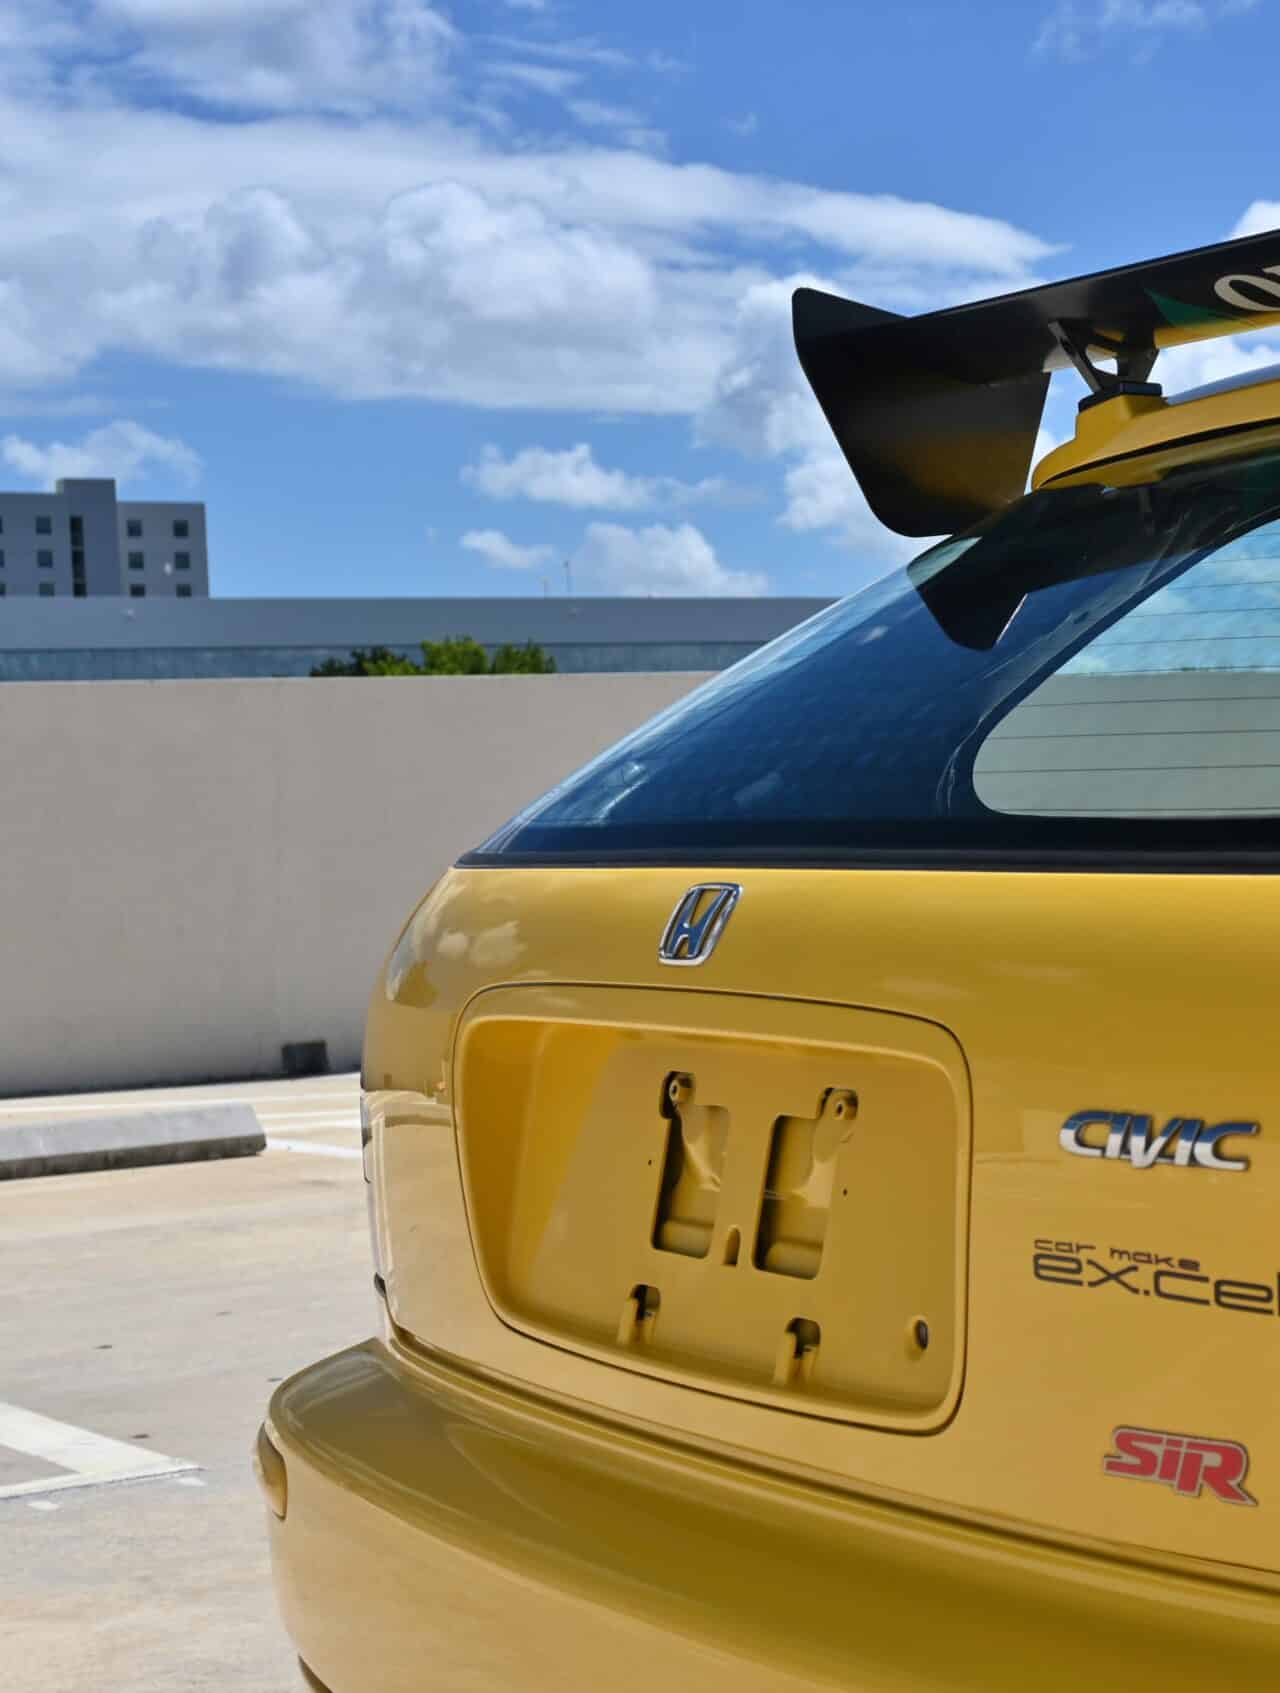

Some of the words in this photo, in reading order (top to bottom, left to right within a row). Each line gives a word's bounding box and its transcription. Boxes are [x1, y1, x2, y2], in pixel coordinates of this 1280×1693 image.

[1059, 1110, 1260, 1171] CIVIC
[1033, 1239, 1096, 1254] car
[1109, 1247, 1201, 1271] make
